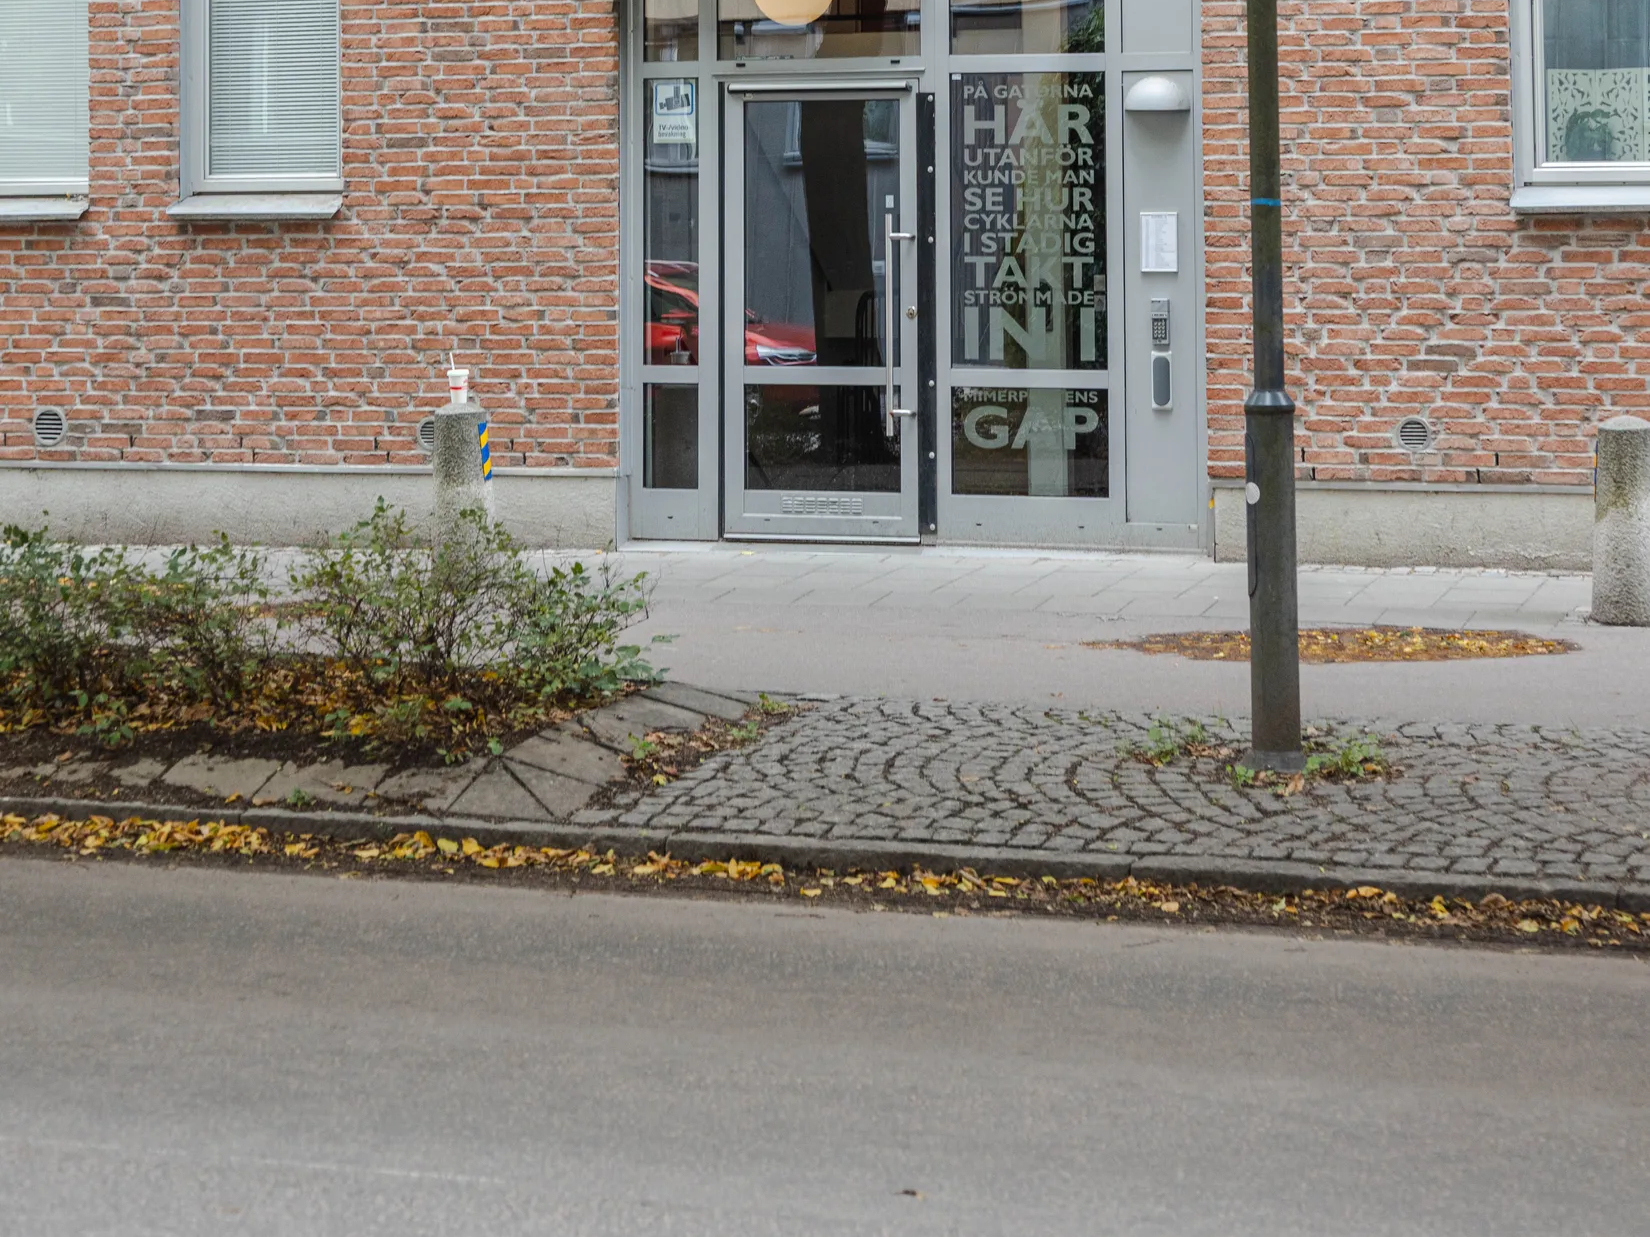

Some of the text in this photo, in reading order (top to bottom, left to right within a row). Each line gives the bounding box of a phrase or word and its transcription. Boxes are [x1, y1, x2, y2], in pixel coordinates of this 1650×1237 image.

[963, 80, 1094, 99] PÅ GATORNA
[963, 144, 1095, 167] UTANFÖR
[963, 169, 1095, 185] KUNDE MAN
[963, 187, 1094, 212] SE HUR
[963, 213, 1095, 230] CYKLARNA
[963, 232, 1095, 253] I STADIG
[964, 256, 1095, 288] TAKT
[964, 287, 1095, 305] STRÖMMADE
[963, 390, 1099, 403] MIMERPENS
